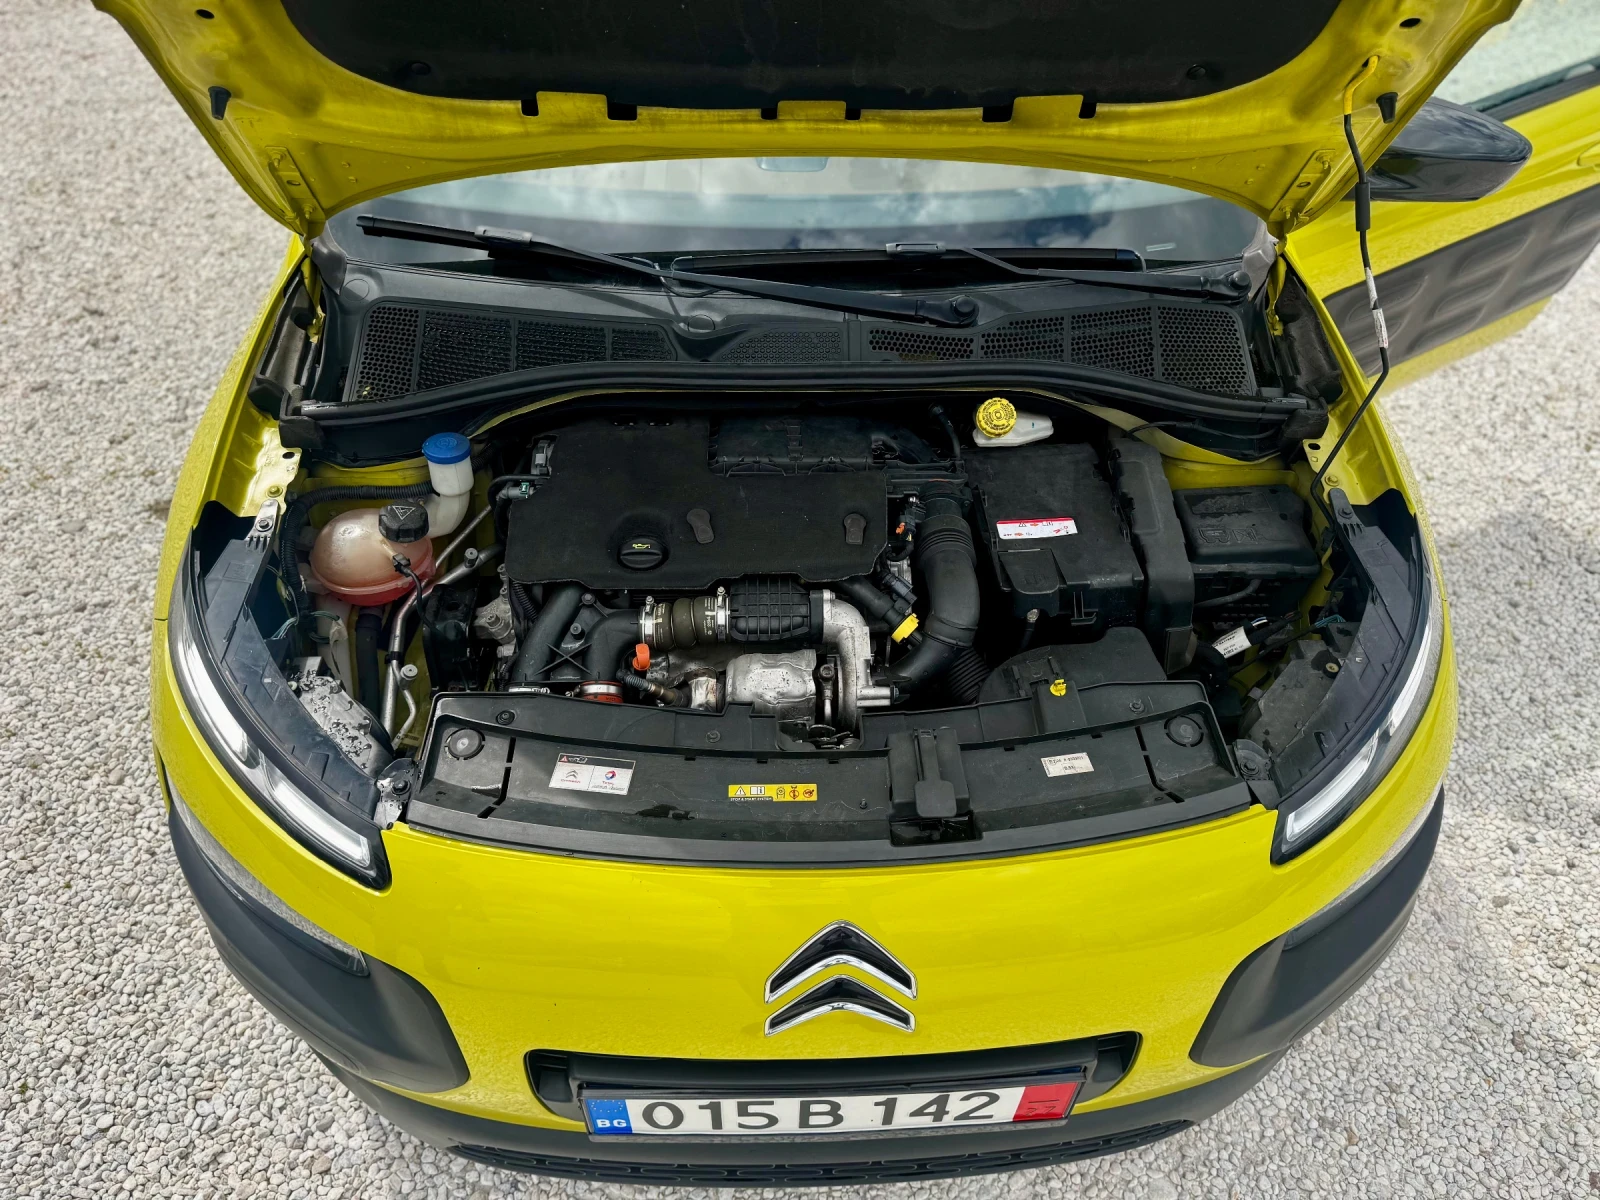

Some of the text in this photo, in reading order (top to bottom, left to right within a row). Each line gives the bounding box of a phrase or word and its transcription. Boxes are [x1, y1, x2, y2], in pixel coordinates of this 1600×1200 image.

[641, 1091, 1001, 1130] 015 B 142
[596, 1118, 627, 1128] BG
